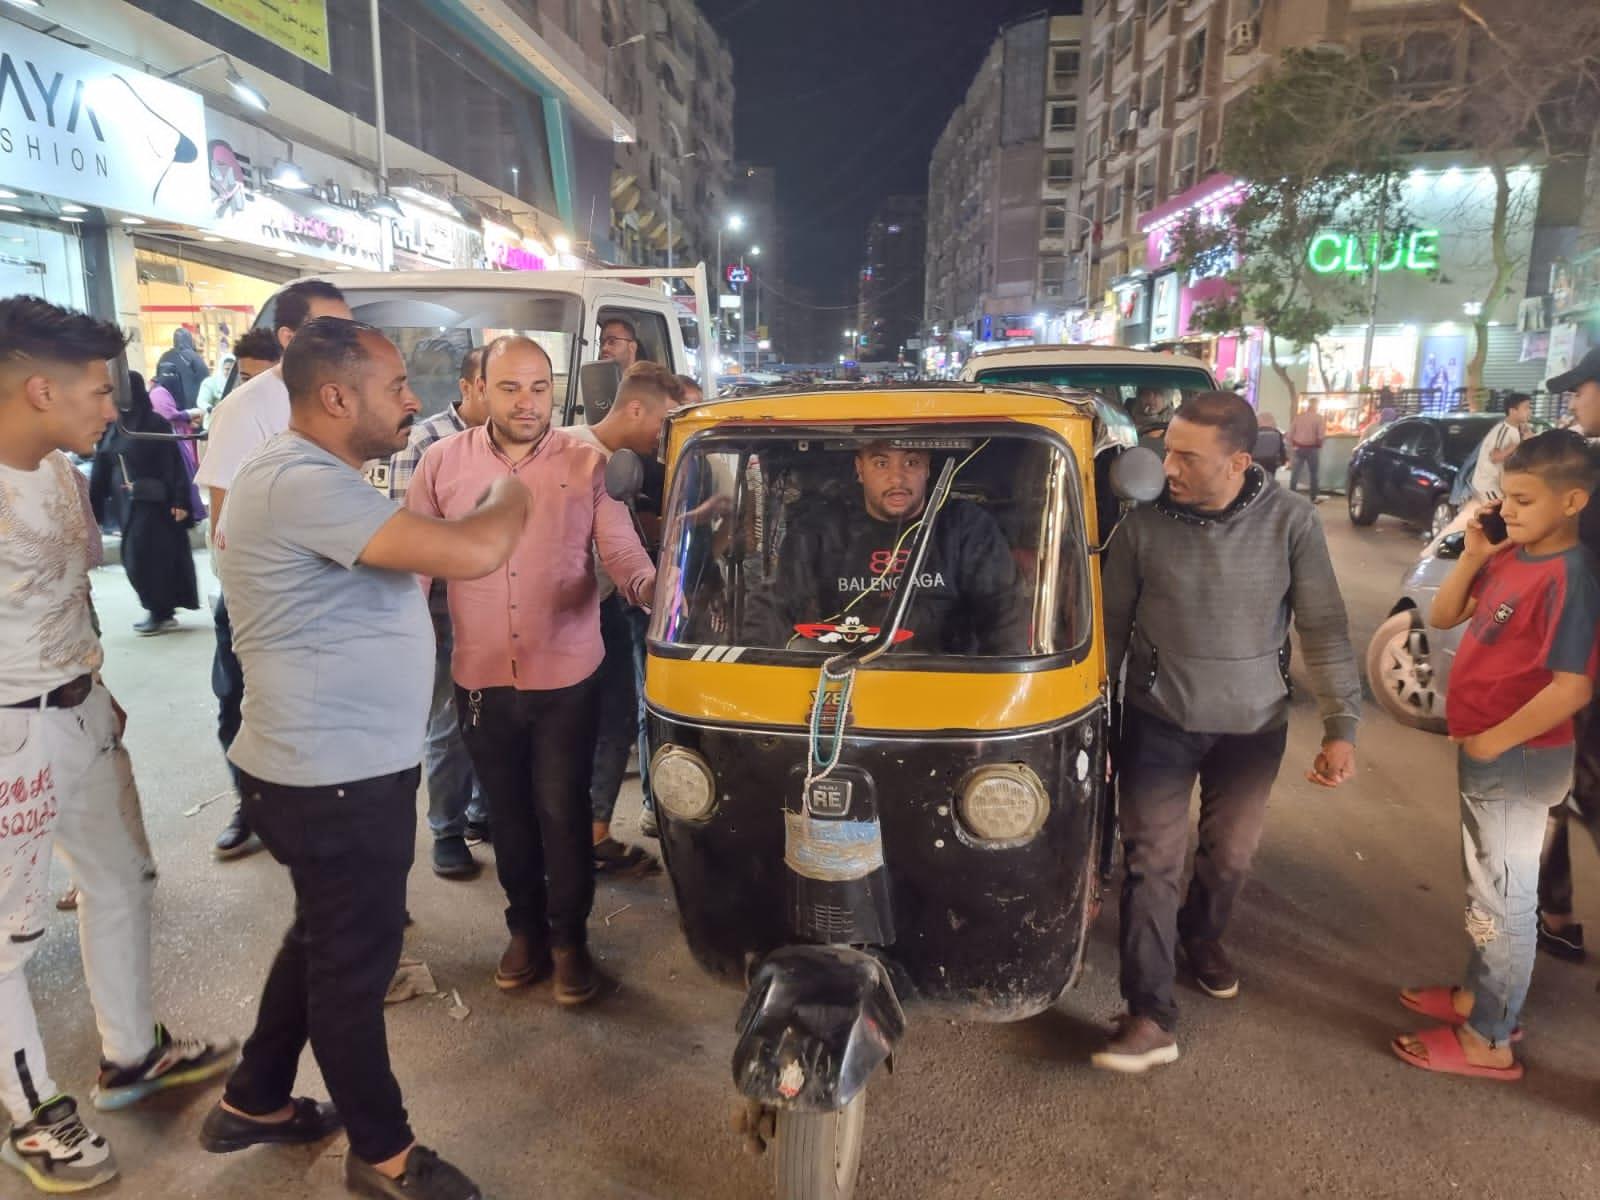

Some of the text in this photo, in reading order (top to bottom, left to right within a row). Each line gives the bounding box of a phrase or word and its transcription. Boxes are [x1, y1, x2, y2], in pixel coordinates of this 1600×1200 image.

[1308, 230, 1439, 272] CLUE
[838, 573, 945, 592] BALENCAGA
[813, 790, 841, 808] RE
